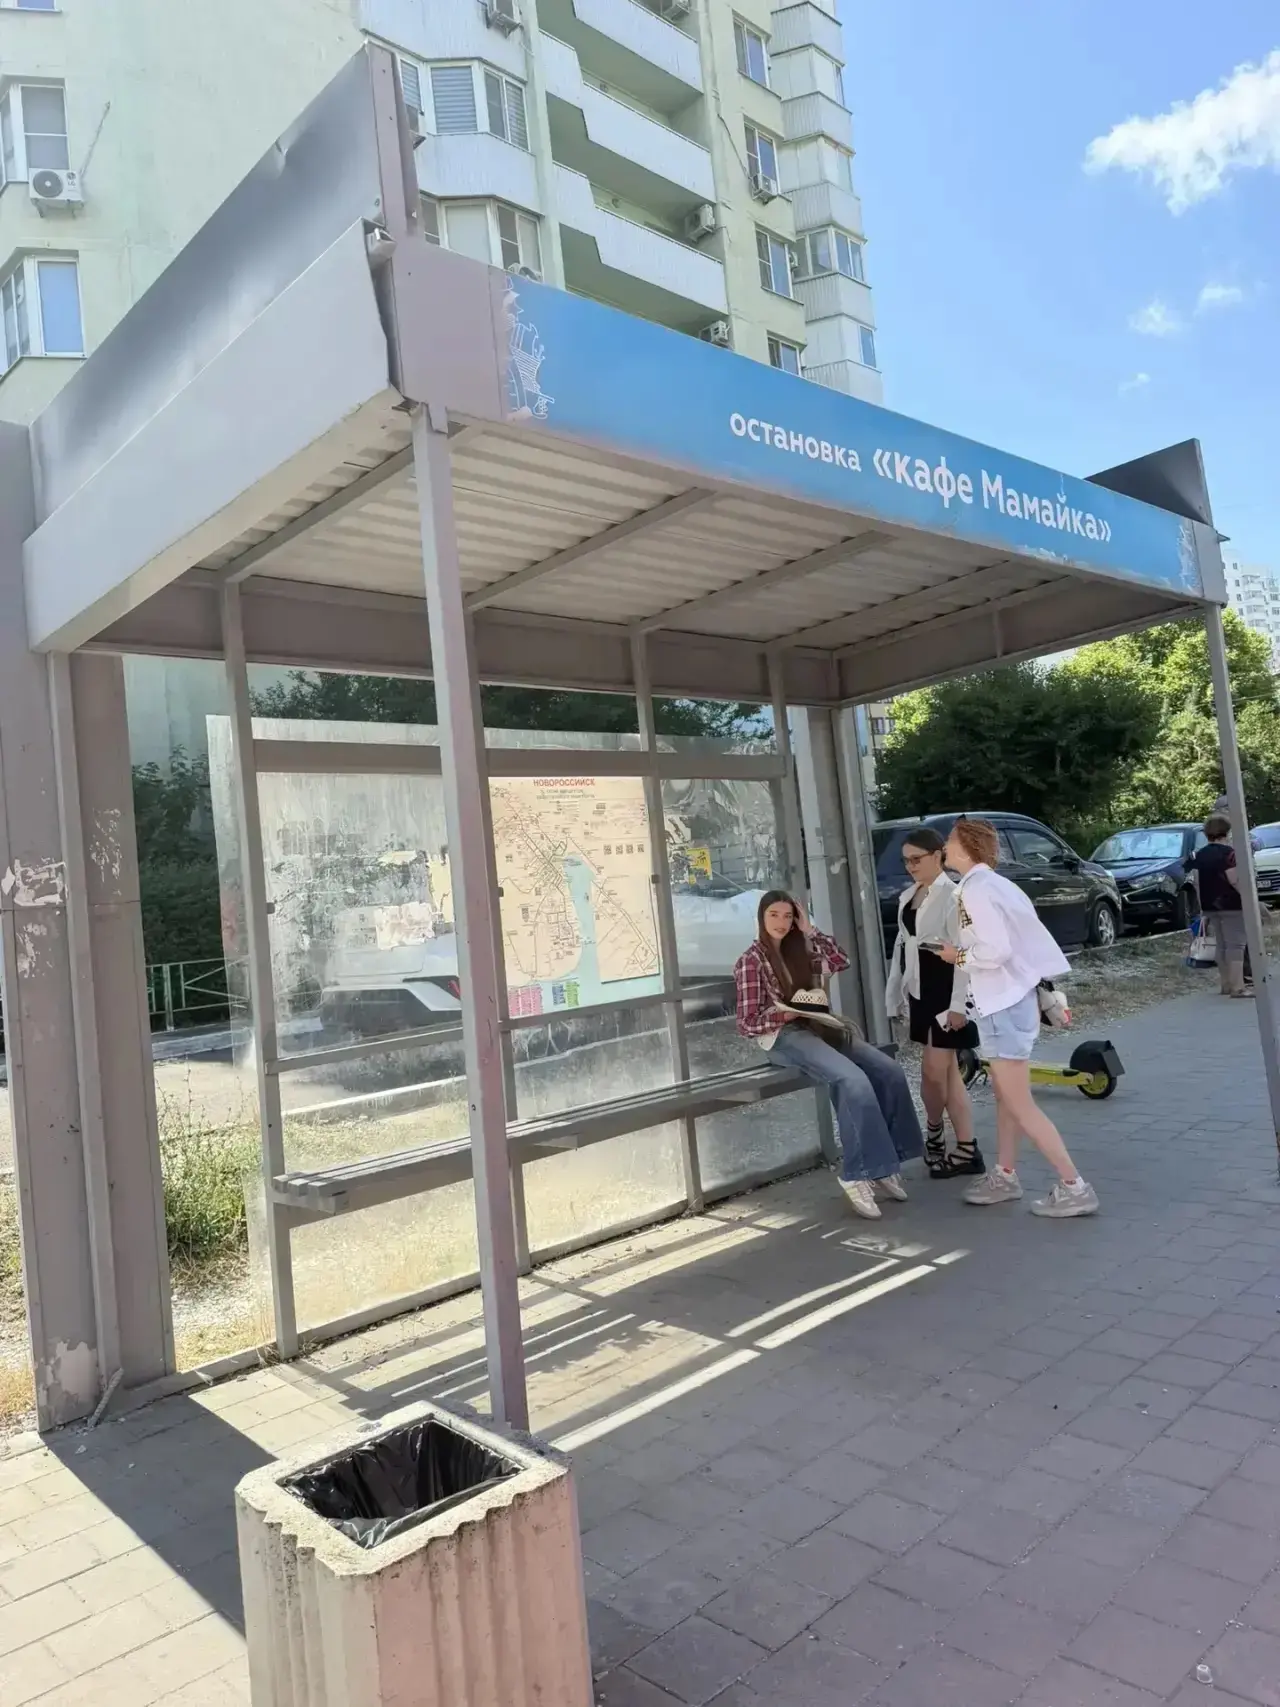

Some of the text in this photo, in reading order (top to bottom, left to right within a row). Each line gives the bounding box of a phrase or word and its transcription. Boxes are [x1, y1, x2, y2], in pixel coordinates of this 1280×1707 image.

[729, 412, 862, 473] остановка
[980, 468, 1113, 543] Мамайка»
[532, 778, 596, 787] НОВОРОССИЙСК
